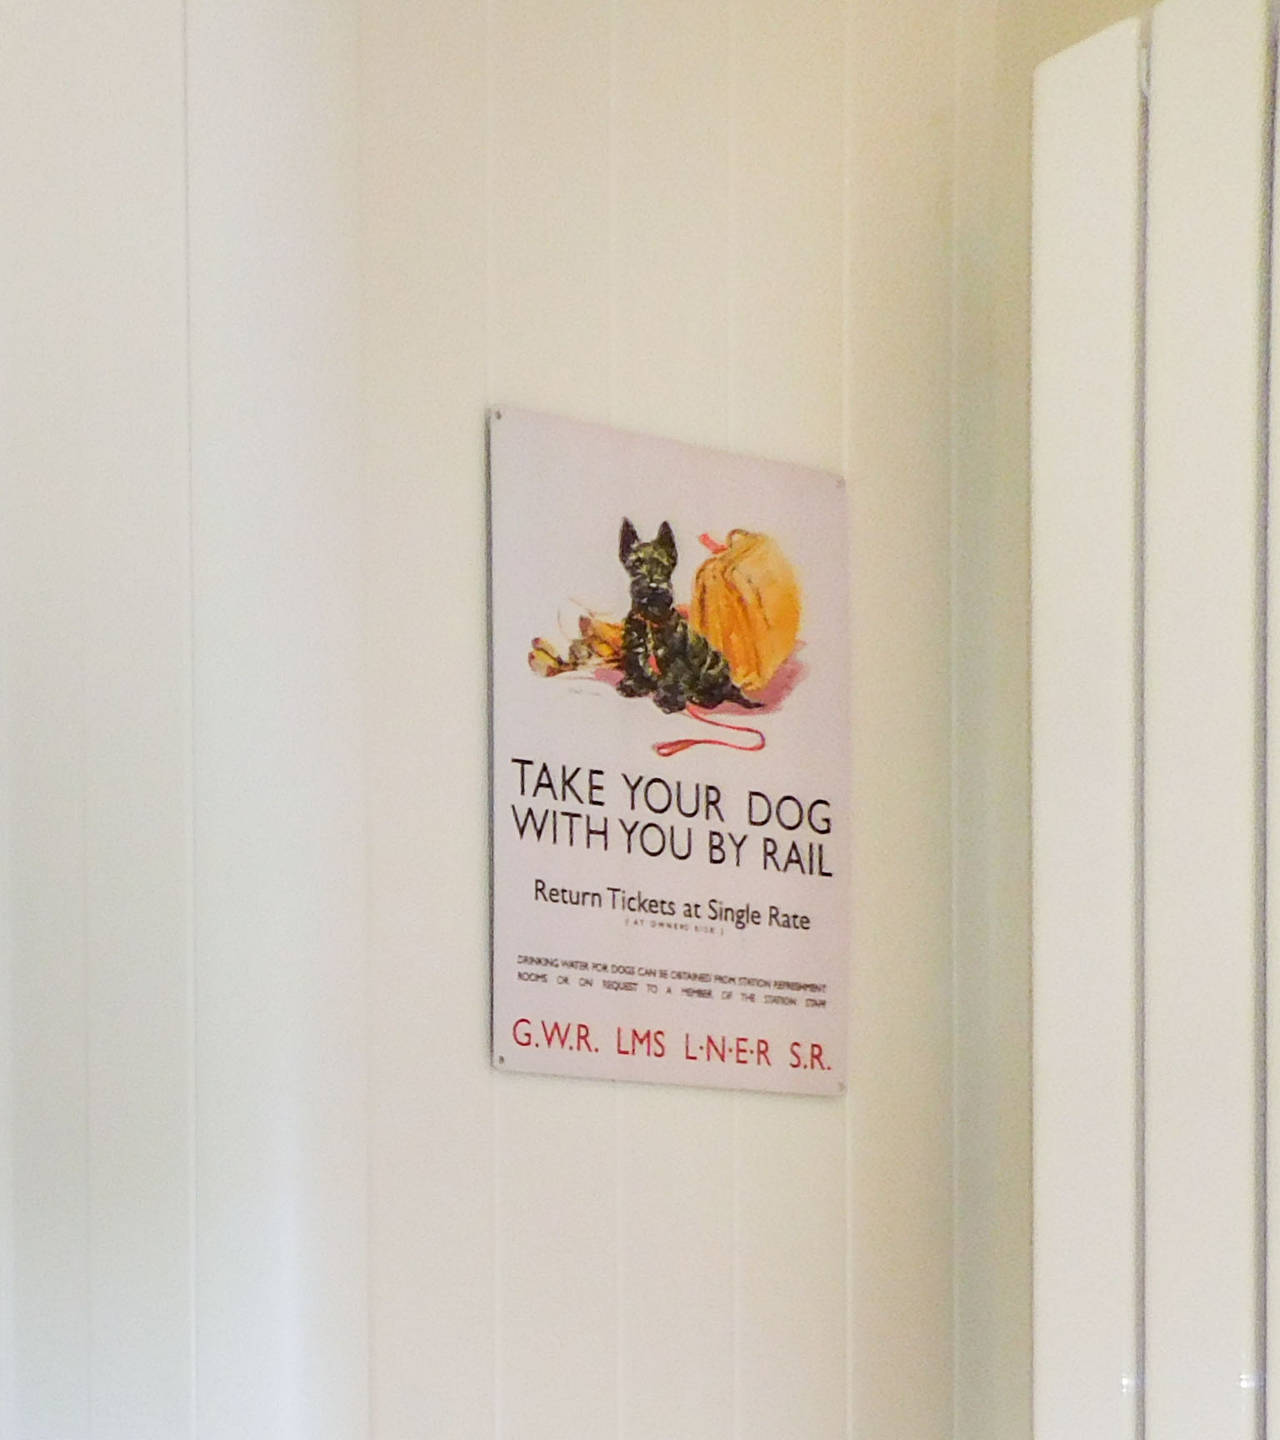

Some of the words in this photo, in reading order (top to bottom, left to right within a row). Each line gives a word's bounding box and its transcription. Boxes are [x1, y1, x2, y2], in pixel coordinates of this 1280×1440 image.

[511, 758, 605, 807] TAKE
[621, 772, 726, 823] YOUR
[748, 790, 832, 835] DOG
[511, 804, 608, 851] WITH
[618, 818, 692, 861] YOU
[708, 830, 748, 867] BY
[762, 837, 833, 877] RAIL
[534, 878, 603, 909] Return
[606, 887, 676, 917] Tickets
[682, 901, 701, 920] at
[708, 899, 761, 930] Single
[768, 906, 811, 930] Rate
[517, 954, 559, 968] DRINKING
[561, 960, 590, 971] WATER
[592, 962, 609, 973] FOR
[611, 964, 636, 976] DOGS
[637, 967, 657, 978] CAN
[659, 969, 668, 979] BE
[670, 970, 712, 983] OBTAINED
[714, 974, 737, 985] FROM
[739, 976, 771, 988] STATION
[773, 979, 827, 993] REFRESHMENT
[517, 971, 548, 983] ROOMS
[556, 975, 569, 985] OR
[578, 977, 593, 987] ON
[602, 979, 638, 991] REQUEST
[646, 983, 658, 994] TO
[665, 985, 672, 994] A
[681, 987, 713, 999] MEMBER
[721, 991, 733, 1000] OF
[741, 992, 756, 1003] THE
[764, 994, 797, 1006] STATION
[512, 1017, 600, 1054] G.W.R.
[616, 1026, 666, 1058] LMS
[789, 1041, 833, 1071] S.R.
